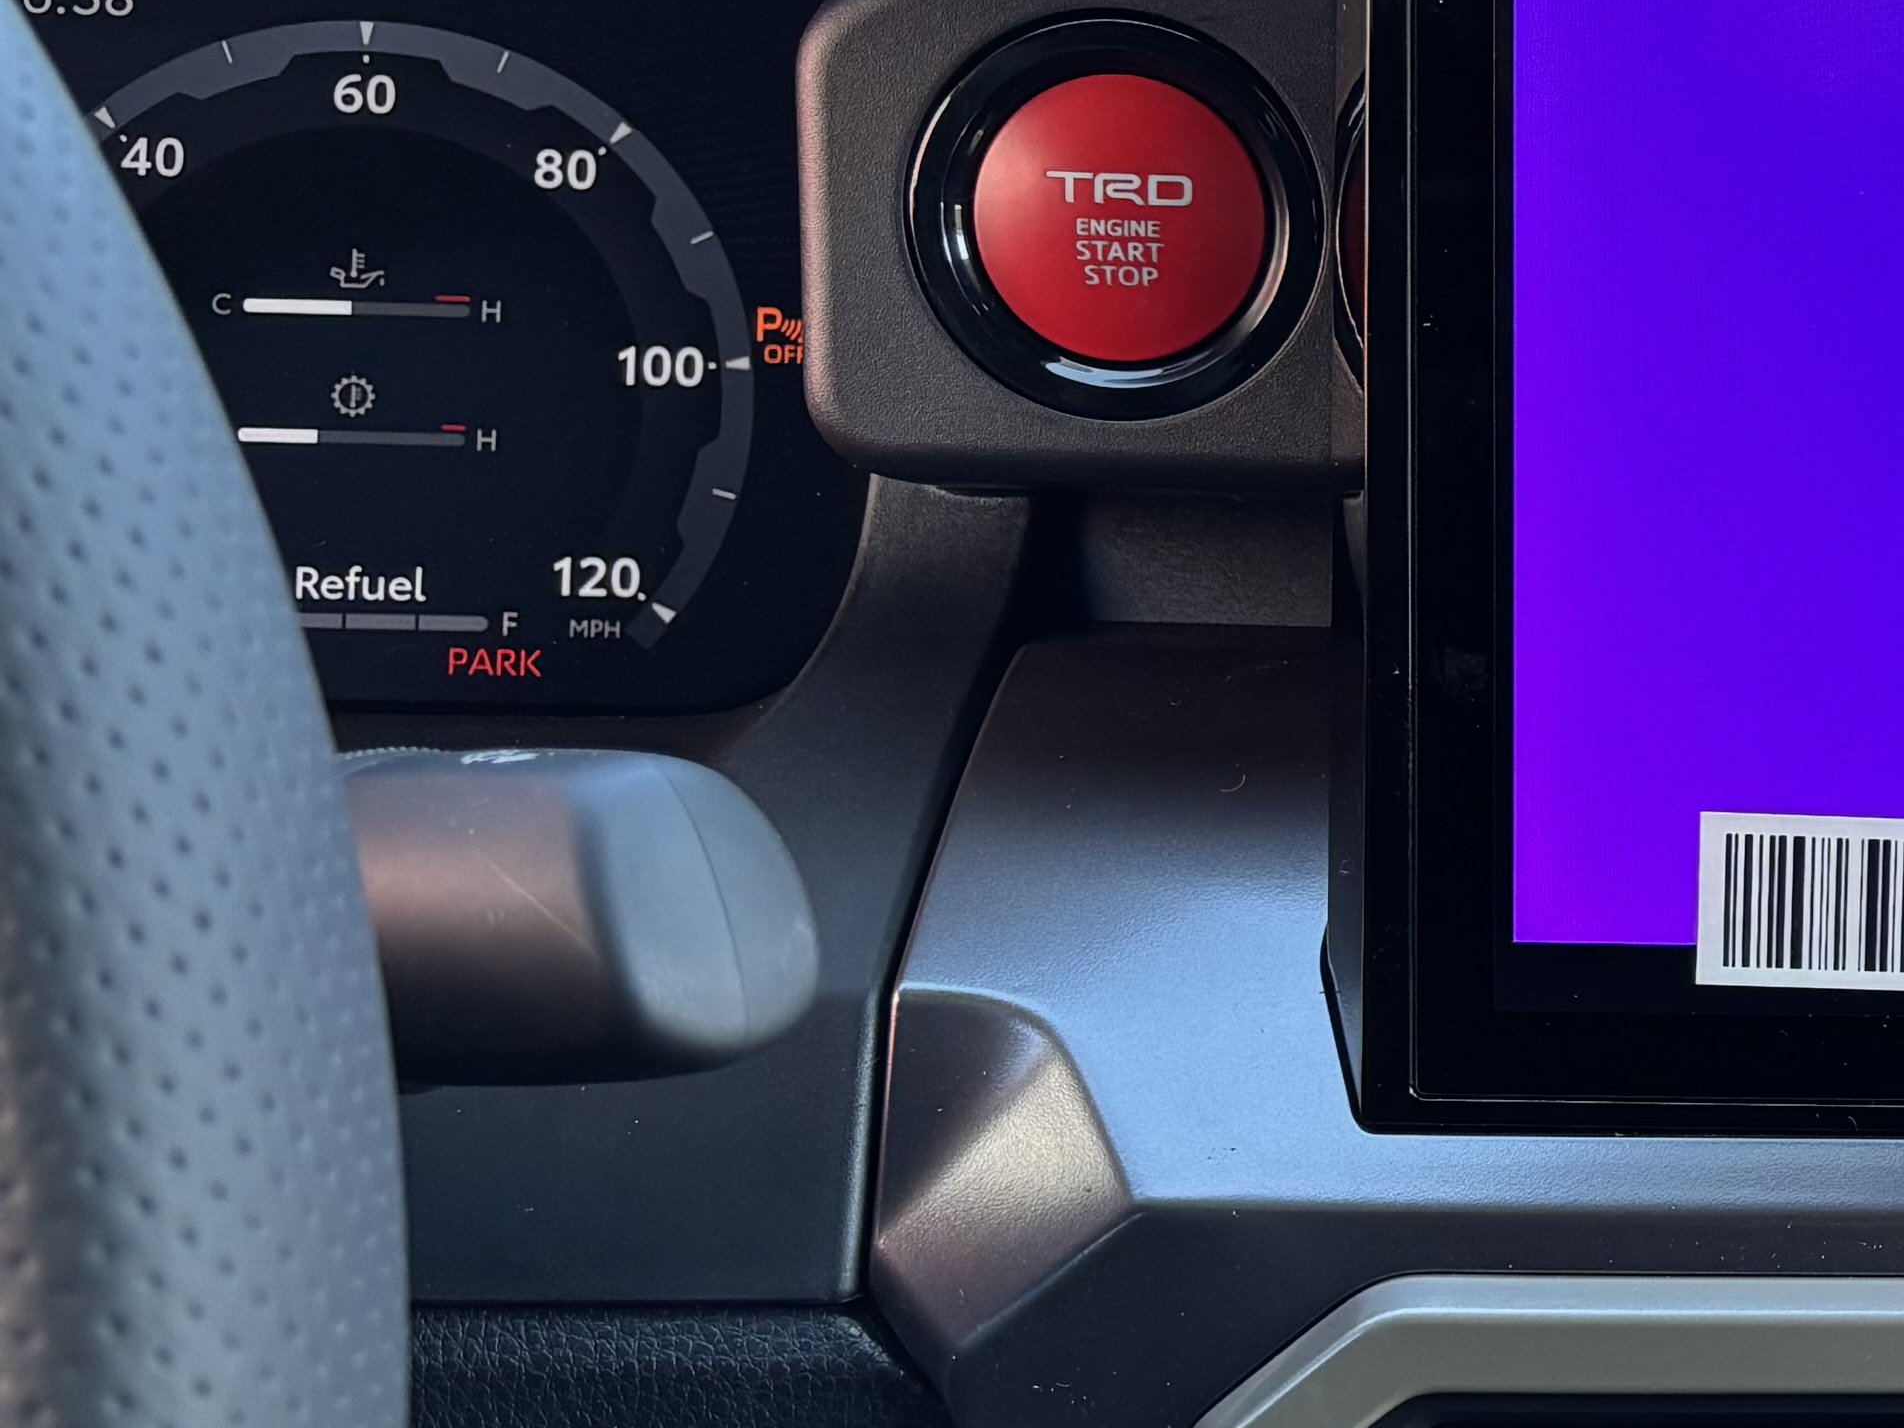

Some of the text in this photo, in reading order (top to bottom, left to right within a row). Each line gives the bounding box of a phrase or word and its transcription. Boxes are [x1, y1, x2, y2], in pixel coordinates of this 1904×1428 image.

[334, 74, 395, 113] 60
[120, 139, 184, 176] 40
[534, 149, 596, 189] 80
[1047, 171, 1195, 208] TRD
[1077, 218, 1159, 237] ENGINE
[1076, 241, 1163, 262] START
[1085, 265, 1158, 286] STOP
[212, 293, 231, 314] C
[482, 300, 501, 323] H
[619, 346, 703, 386] 100
[477, 429, 496, 451] H
[296, 566, 426, 601] Refuel
[554, 557, 640, 598] 120
[503, 612, 518, 636] F
[570, 619, 620, 638] MPH
[449, 648, 540, 677] PARK
